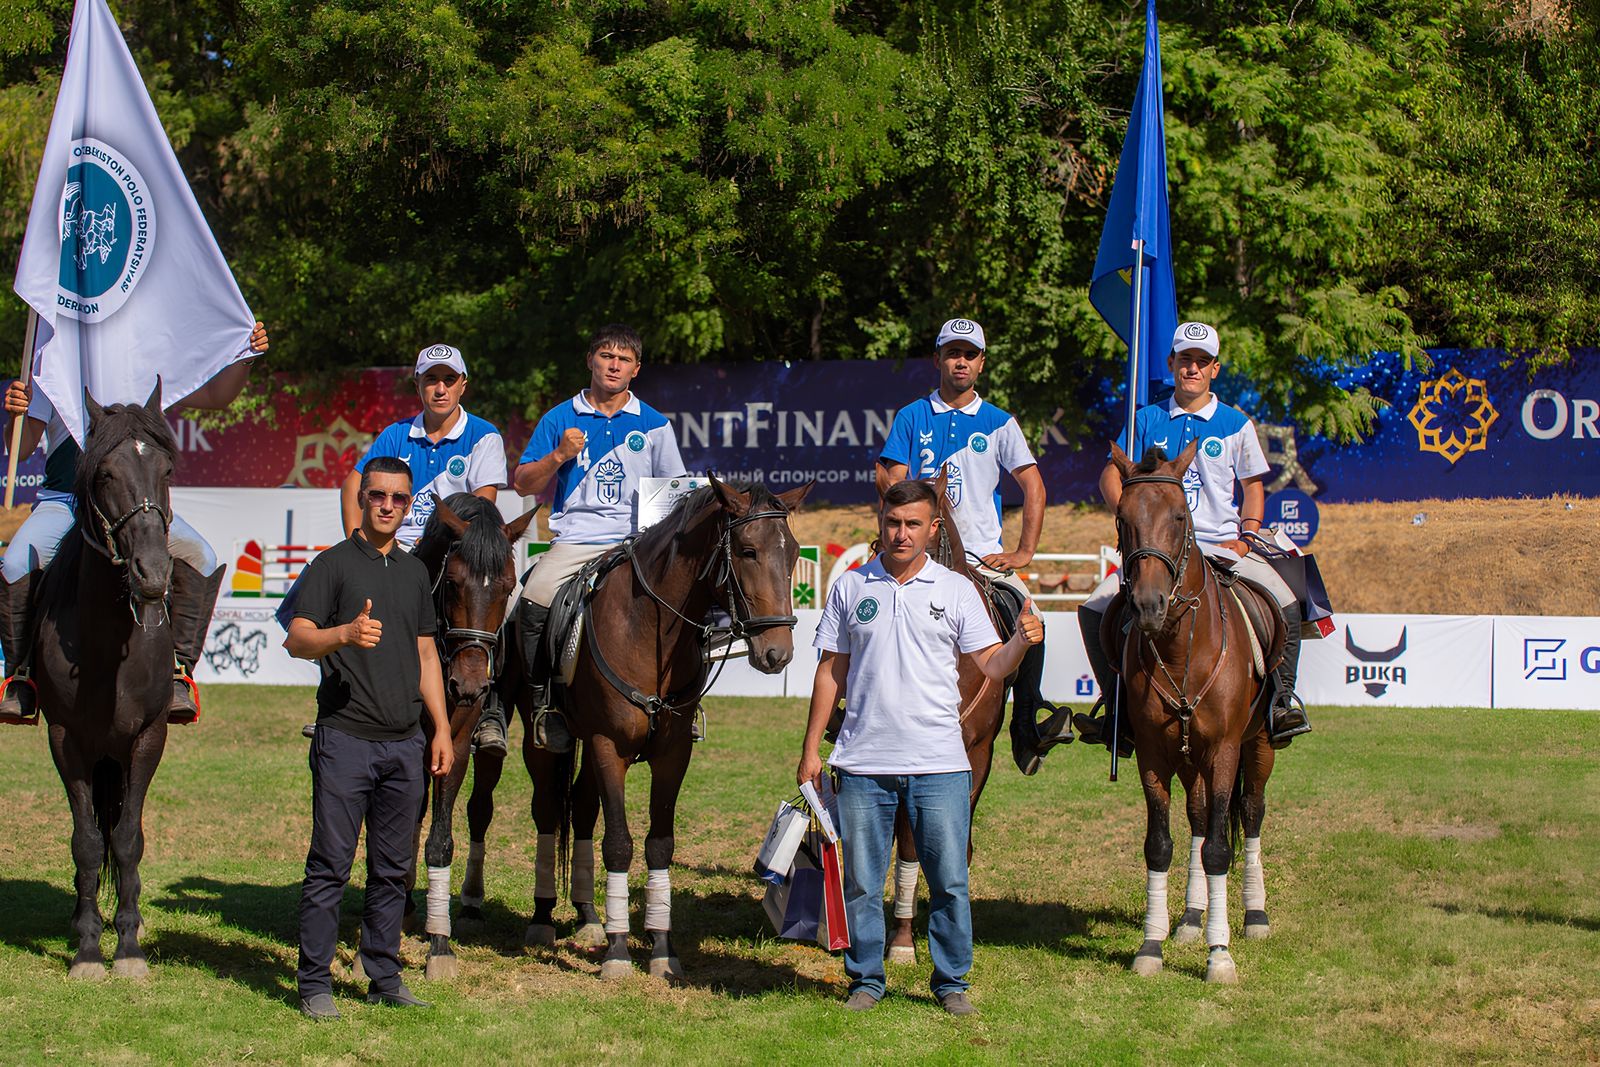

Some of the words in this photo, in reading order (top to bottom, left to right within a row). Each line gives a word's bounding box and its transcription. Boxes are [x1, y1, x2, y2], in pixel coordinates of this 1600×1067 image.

[122, 175, 143, 206] POLO
[120, 207, 148, 294] FEDERATSIYASI
[664, 402, 896, 449] NTFINAN
[577, 447, 592, 472] 4
[919, 448, 935, 474] 2
[769, 470, 850, 483] СПОНСОР
[1345, 665, 1407, 685] BUKA
